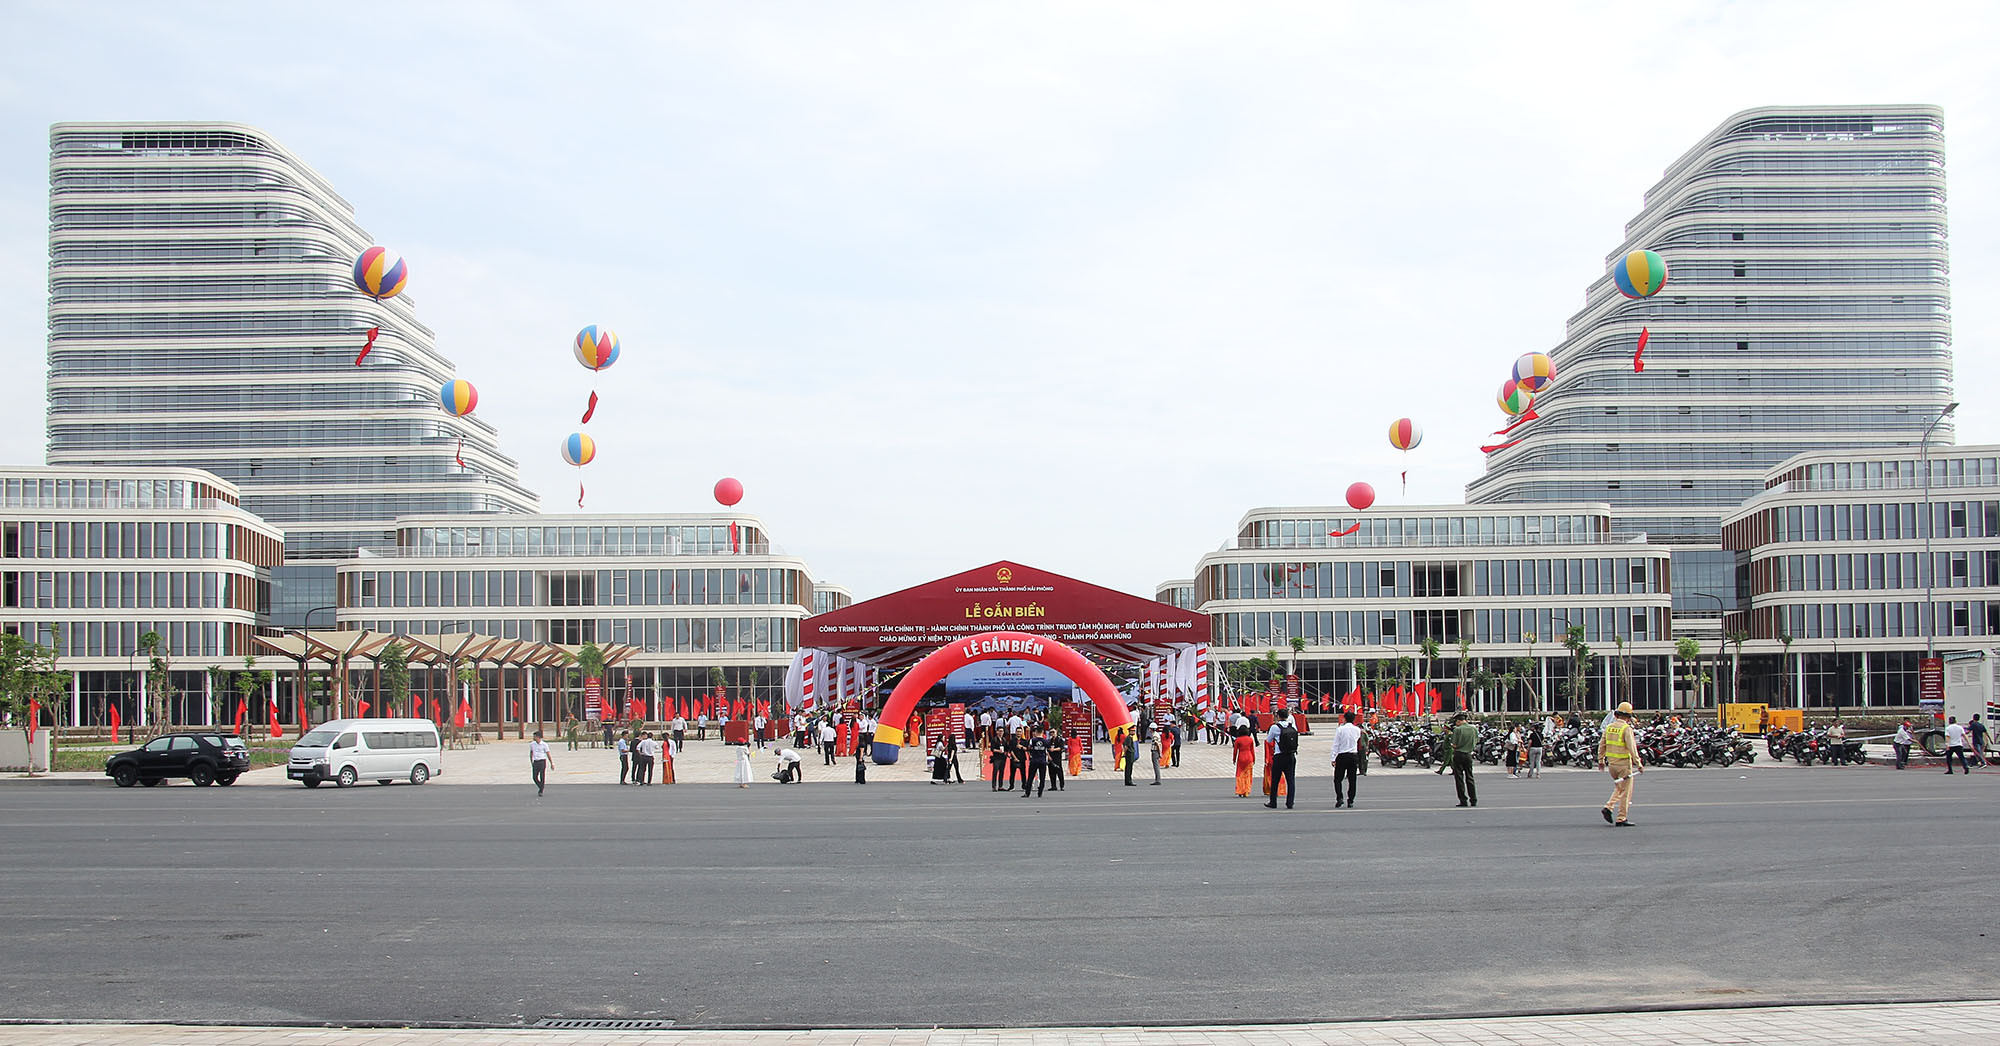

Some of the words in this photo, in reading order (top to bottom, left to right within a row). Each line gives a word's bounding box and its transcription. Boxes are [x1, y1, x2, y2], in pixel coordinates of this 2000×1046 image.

[966, 602, 981, 618] LỄ
[984, 602, 1012, 617] GẮN
[1015, 602, 1045, 617] BIỂN
[992, 622, 1006, 630] PHỐ
[1092, 622, 1103, 631] HỘI
[1125, 620, 1139, 629] BIỂU
[1140, 620, 1155, 629] DIỄN
[1178, 620, 1192, 628] PHỐ
[927, 634, 943, 643] NIỆM
[1085, 631, 1098, 640] PHỐ
[963, 640, 981, 658] LỄ
[982, 636, 1009, 653] GẮN
[1011, 638, 1044, 656] BIỂN
